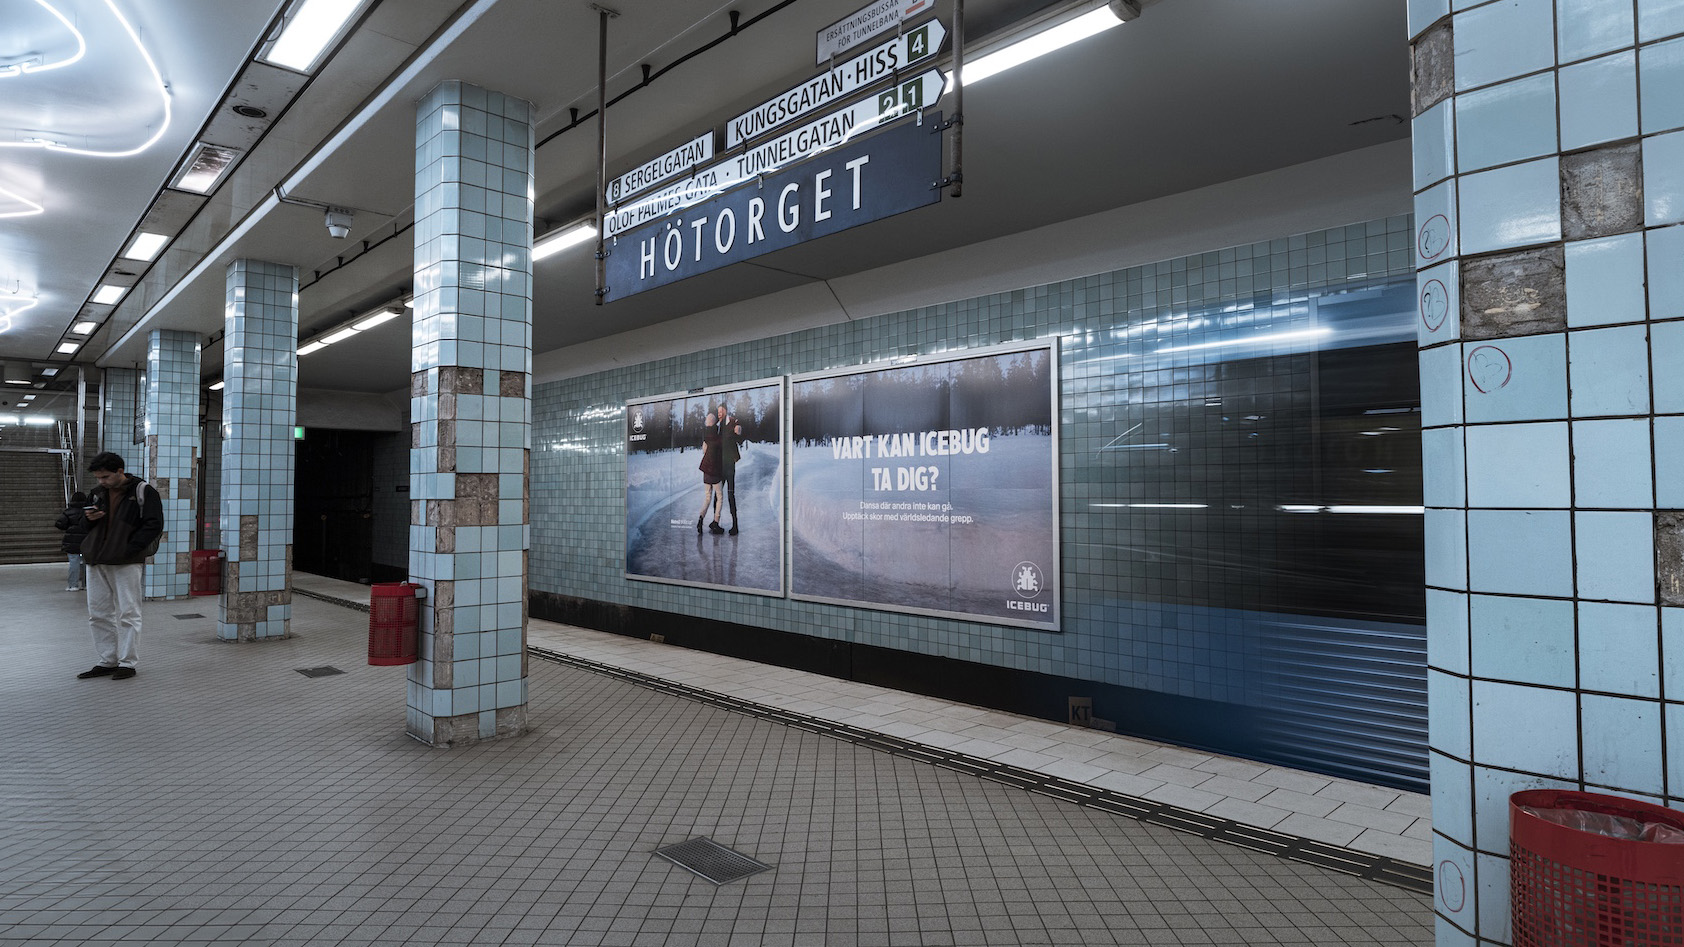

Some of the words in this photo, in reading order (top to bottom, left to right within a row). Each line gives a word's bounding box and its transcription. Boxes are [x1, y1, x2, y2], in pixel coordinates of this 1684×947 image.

[853, 9, 899, 40] TUNNELBANA
[735, 69, 843, 141] KUNGSGATAN
[856, 43, 898, 84] HISS
[911, 33, 924, 54] 4
[609, 210, 635, 233] OLOF
[638, 186, 681, 221] PALMES
[685, 171, 718, 200] GATA
[737, 109, 854, 178] TUNNELGATAN
[883, 96, 895, 116] 2
[907, 85, 916, 106] 1
[612, 183, 620, 198] 8
[625, 140, 704, 194] SERGELGATAN
[640, 154, 870, 280] HÖTORGET
[831, 435, 873, 460] VART
[877, 432, 915, 458] KAN
[919, 427, 990, 457] ICEBUG
[871, 467, 892, 491] TA
[897, 465, 940, 492] DIG?
[842, 512, 868, 522] Upptäck
[869, 512, 883, 521] skor
[884, 512, 899, 521] med
[900, 512, 949, 523] världsledande
[951, 515, 974, 525] grepp.
[860, 501, 879, 510] Dansa
[880, 501, 891, 510] där
[892, 501, 912, 511] andra
[913, 502, 926, 511] inte
[927, 502, 940, 511] kan
[942, 501, 954, 513] gå.
[1006, 600, 1048, 613] ICEBUG
[1071, 705, 1090, 721] KT
